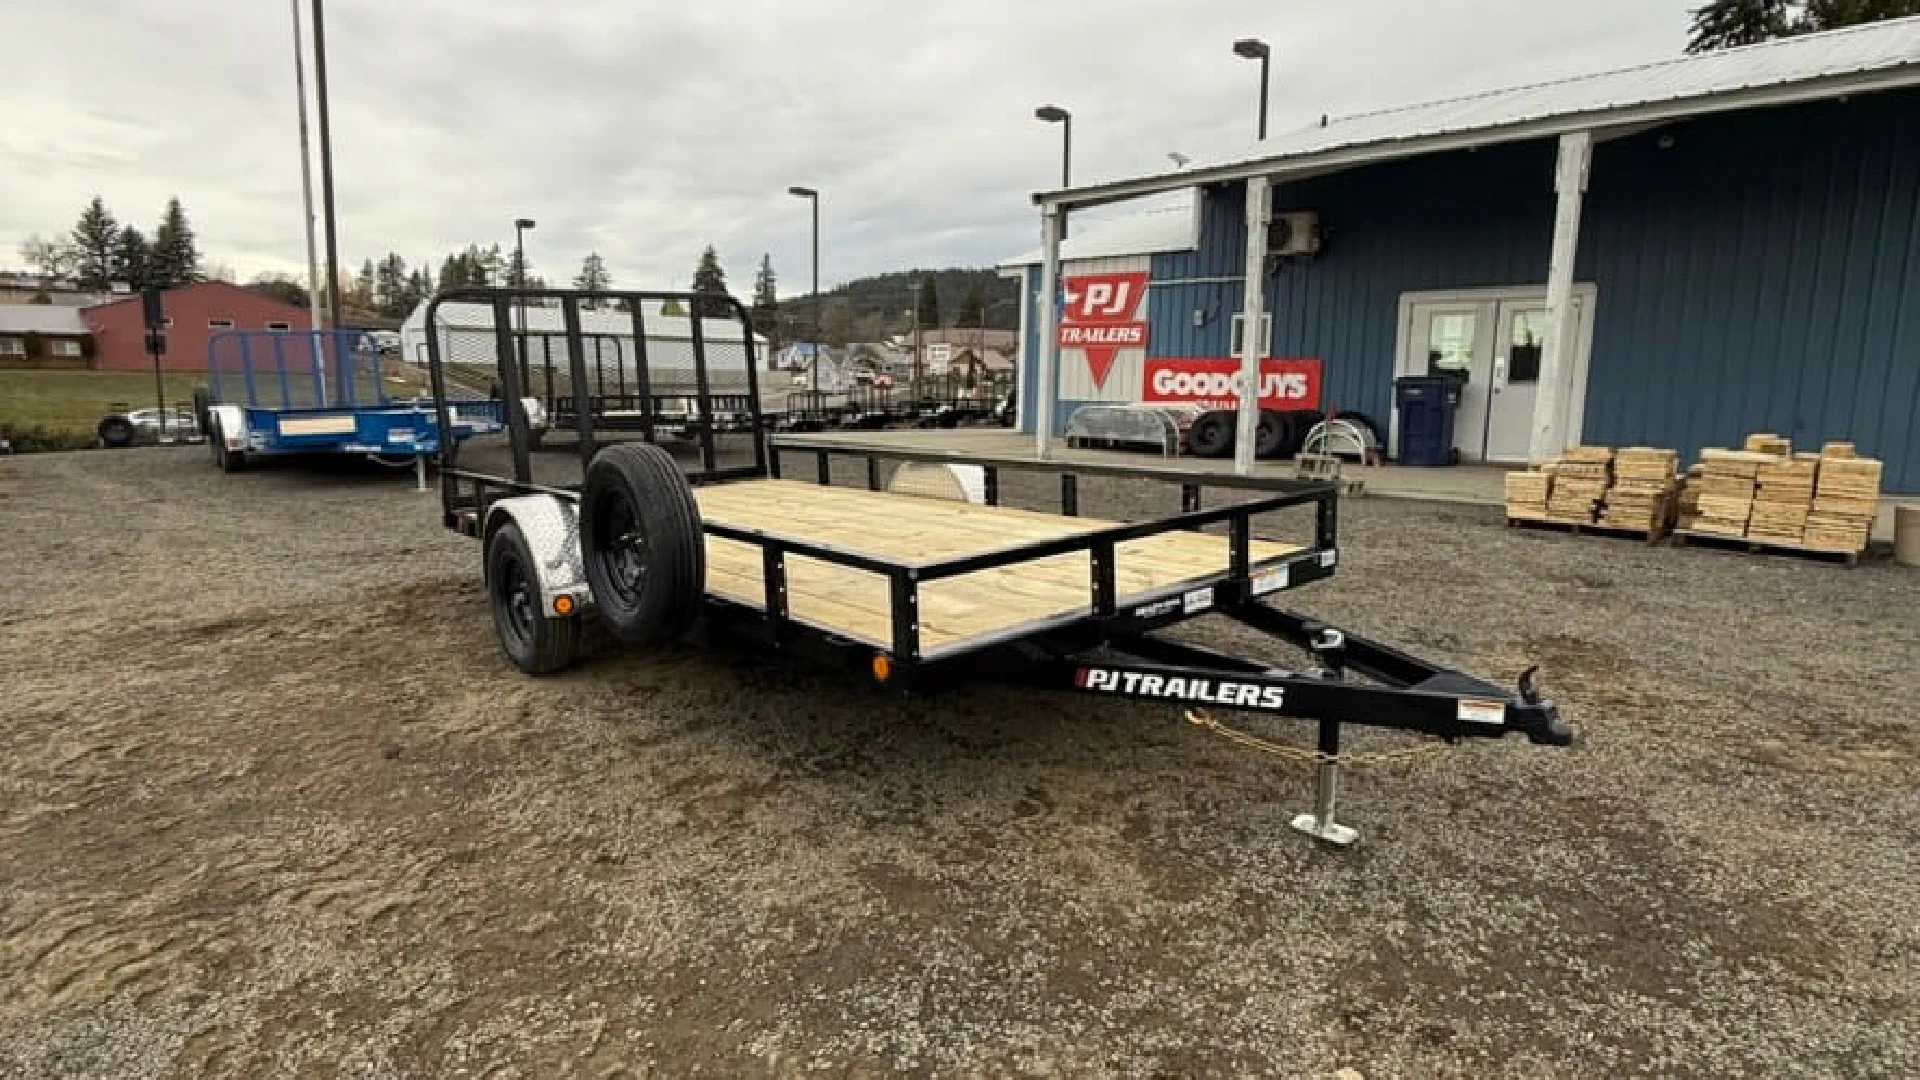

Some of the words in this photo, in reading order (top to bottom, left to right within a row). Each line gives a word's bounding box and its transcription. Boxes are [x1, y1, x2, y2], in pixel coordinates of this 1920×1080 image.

[1083, 281, 1130, 316] PJ
[1061, 327, 1142, 343] TRAILERS
[1087, 669, 1119, 691] PJ
[1123, 671, 1284, 708] TRAILERS
